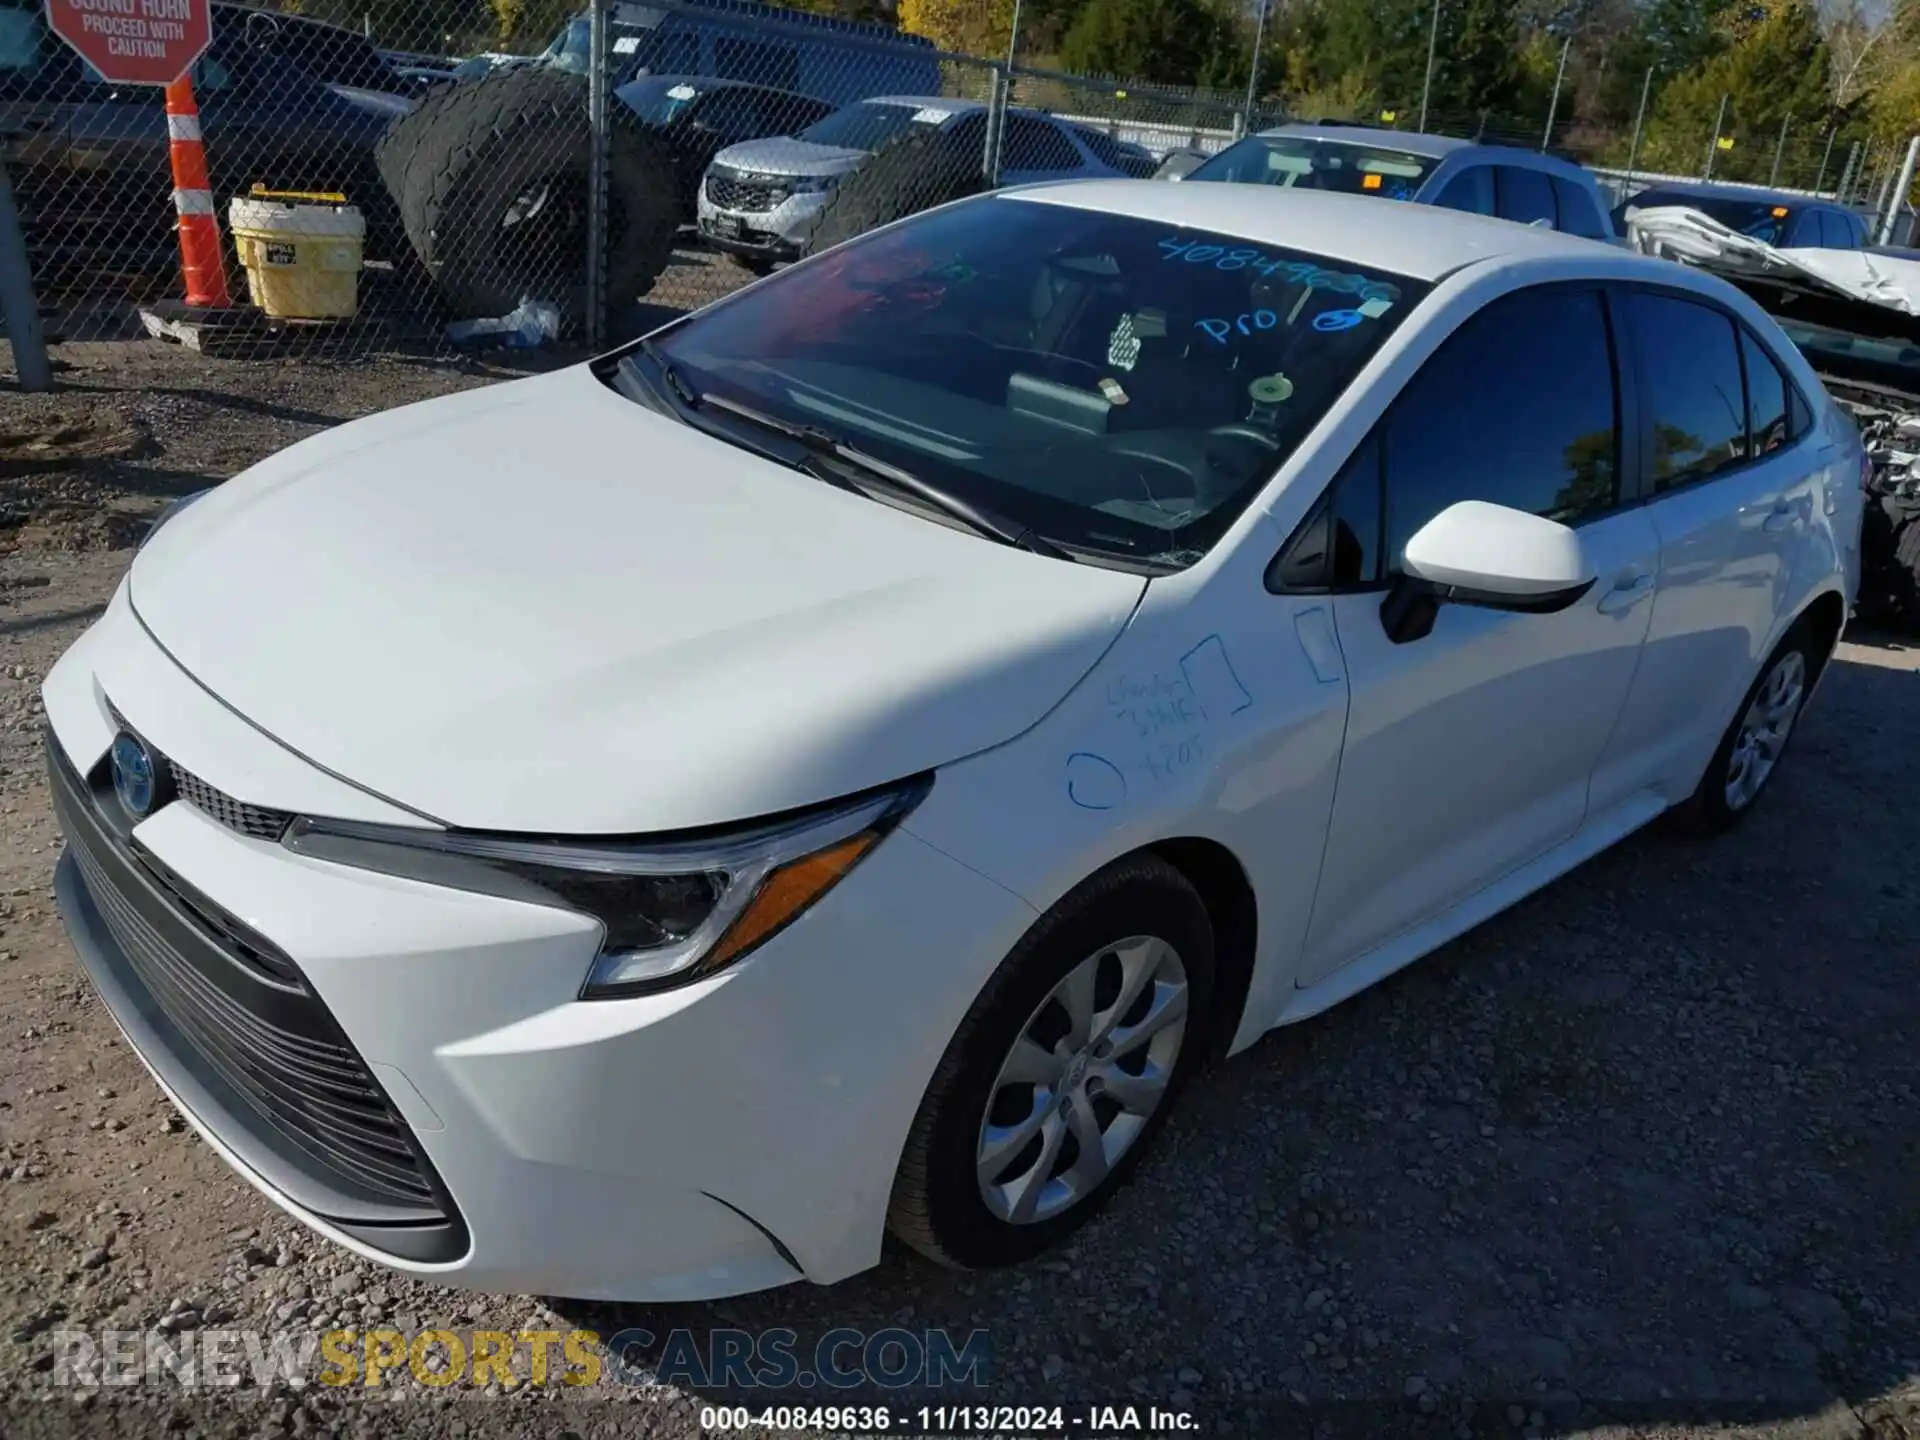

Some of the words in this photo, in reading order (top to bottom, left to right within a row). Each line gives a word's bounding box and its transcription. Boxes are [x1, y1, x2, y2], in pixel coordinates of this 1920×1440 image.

[82, 14, 146, 37] PROCEED
[150, 21, 184, 40] WITH
[108, 37, 166, 58] CAUTION
